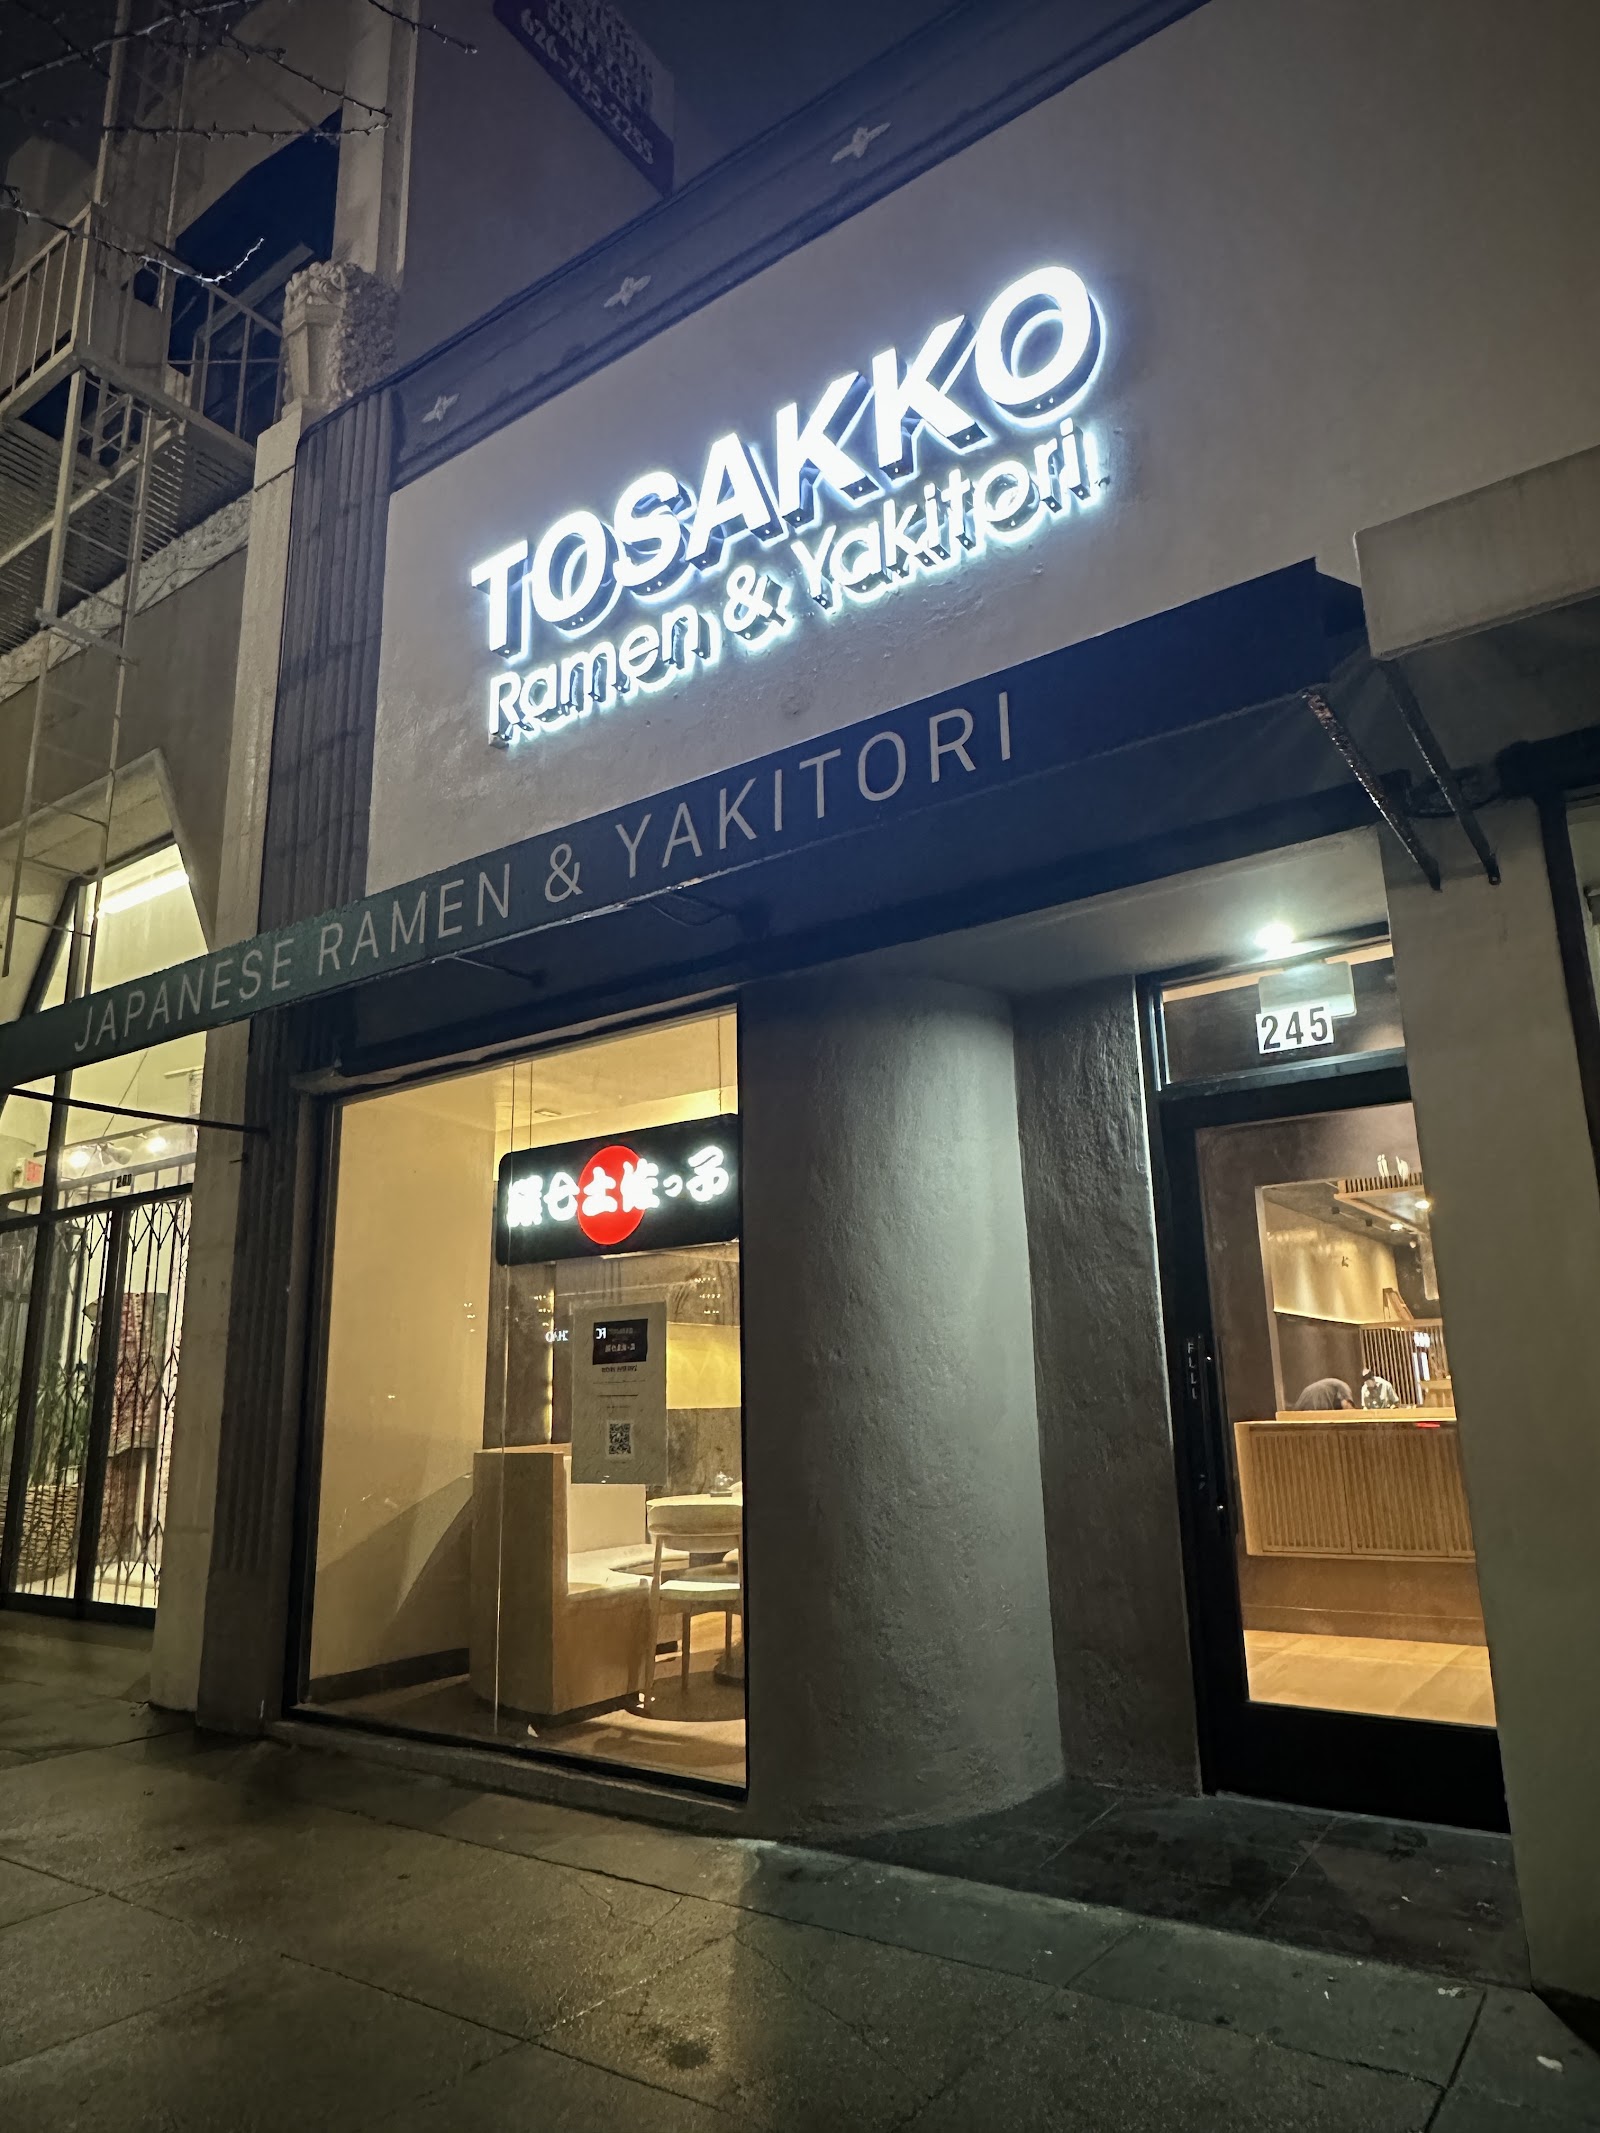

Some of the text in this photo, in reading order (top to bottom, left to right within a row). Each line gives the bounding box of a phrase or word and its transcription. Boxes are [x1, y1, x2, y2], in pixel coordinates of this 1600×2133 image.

[470, 265, 1098, 656] TOSAKKO
[488, 418, 1088, 746] Ramen & Yakitori
[74, 691, 1012, 1052] JAPANESE RAMEN & YAKITORI
[1260, 1006, 1329, 1051] 245
